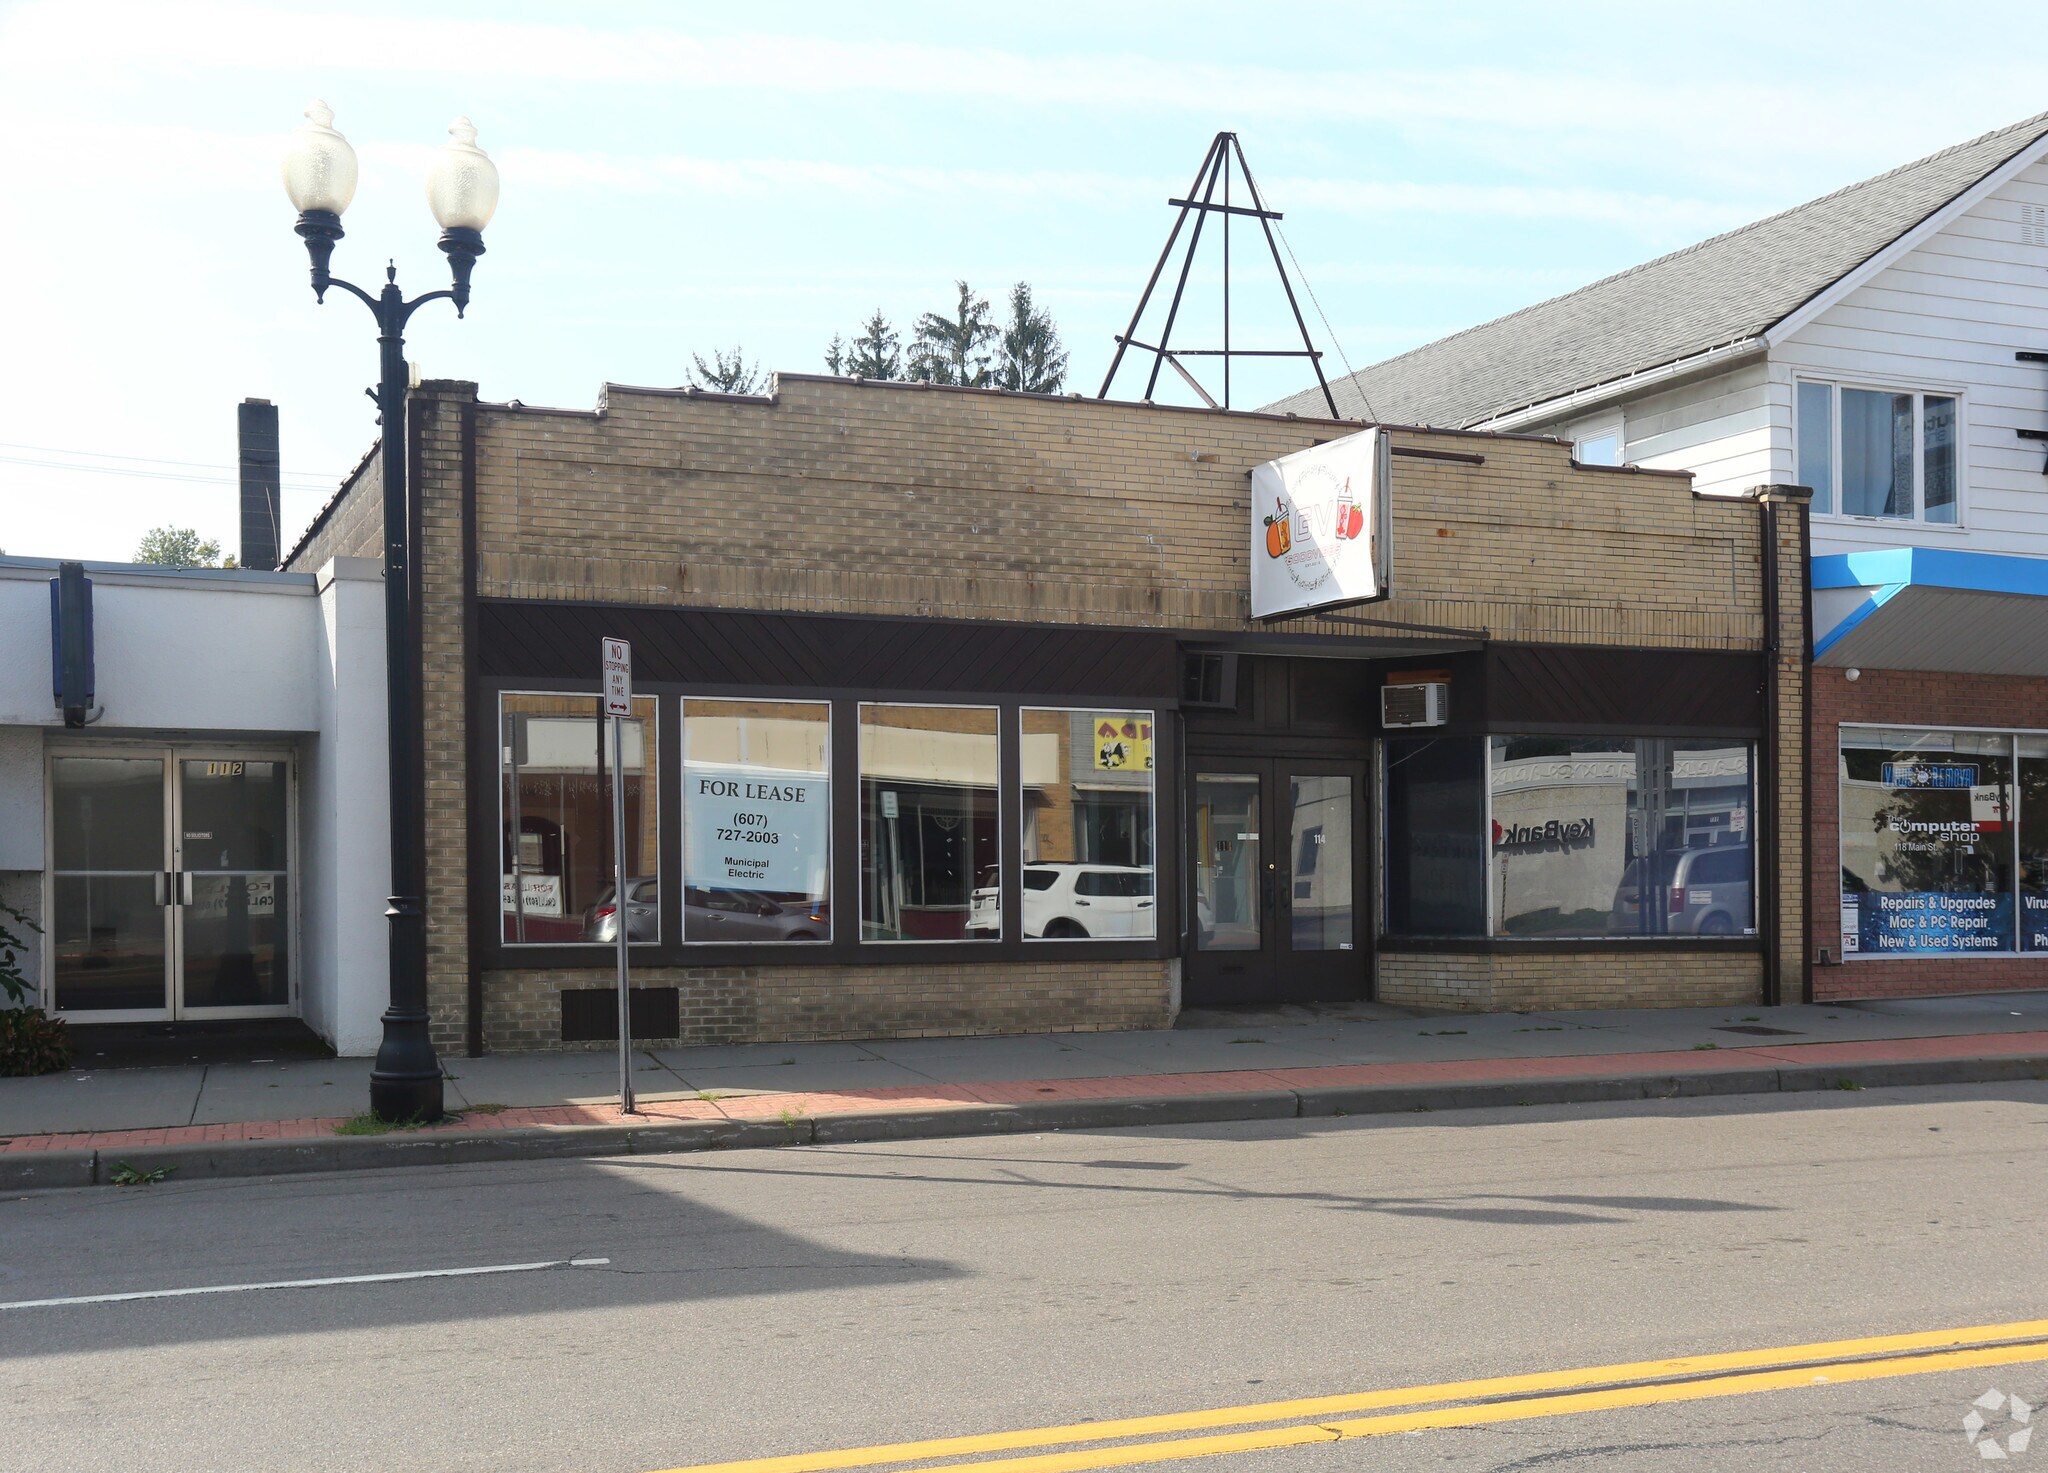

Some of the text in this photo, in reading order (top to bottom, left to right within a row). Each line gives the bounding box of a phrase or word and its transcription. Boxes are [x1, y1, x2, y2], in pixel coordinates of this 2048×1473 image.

[611, 644, 622, 660] NO
[605, 660, 629, 673] STOPPING
[612, 675, 623, 684] ANY
[611, 686, 624, 697] TIME
[211, 763, 241, 773] 112
[1932, 767, 1975, 787] REMOVAL
[699, 780, 806, 803] FOR LEASE
[733, 812, 768, 829] (607)
[716, 828, 779, 844] 727-2003
[1313, 834, 1326, 844] 114
[1940, 830, 1980, 844] shop
[1894, 843, 1907, 851] 118
[1908, 843, 1926, 851] Main
[724, 857, 770, 869] Municipal
[728, 869, 765, 879] Electric
[1880, 896, 1996, 913] Repairs & Upgrades
[1889, 915, 1988, 930] Mac & PC Repair
[1879, 934, 1998, 949] New & Used Systems
